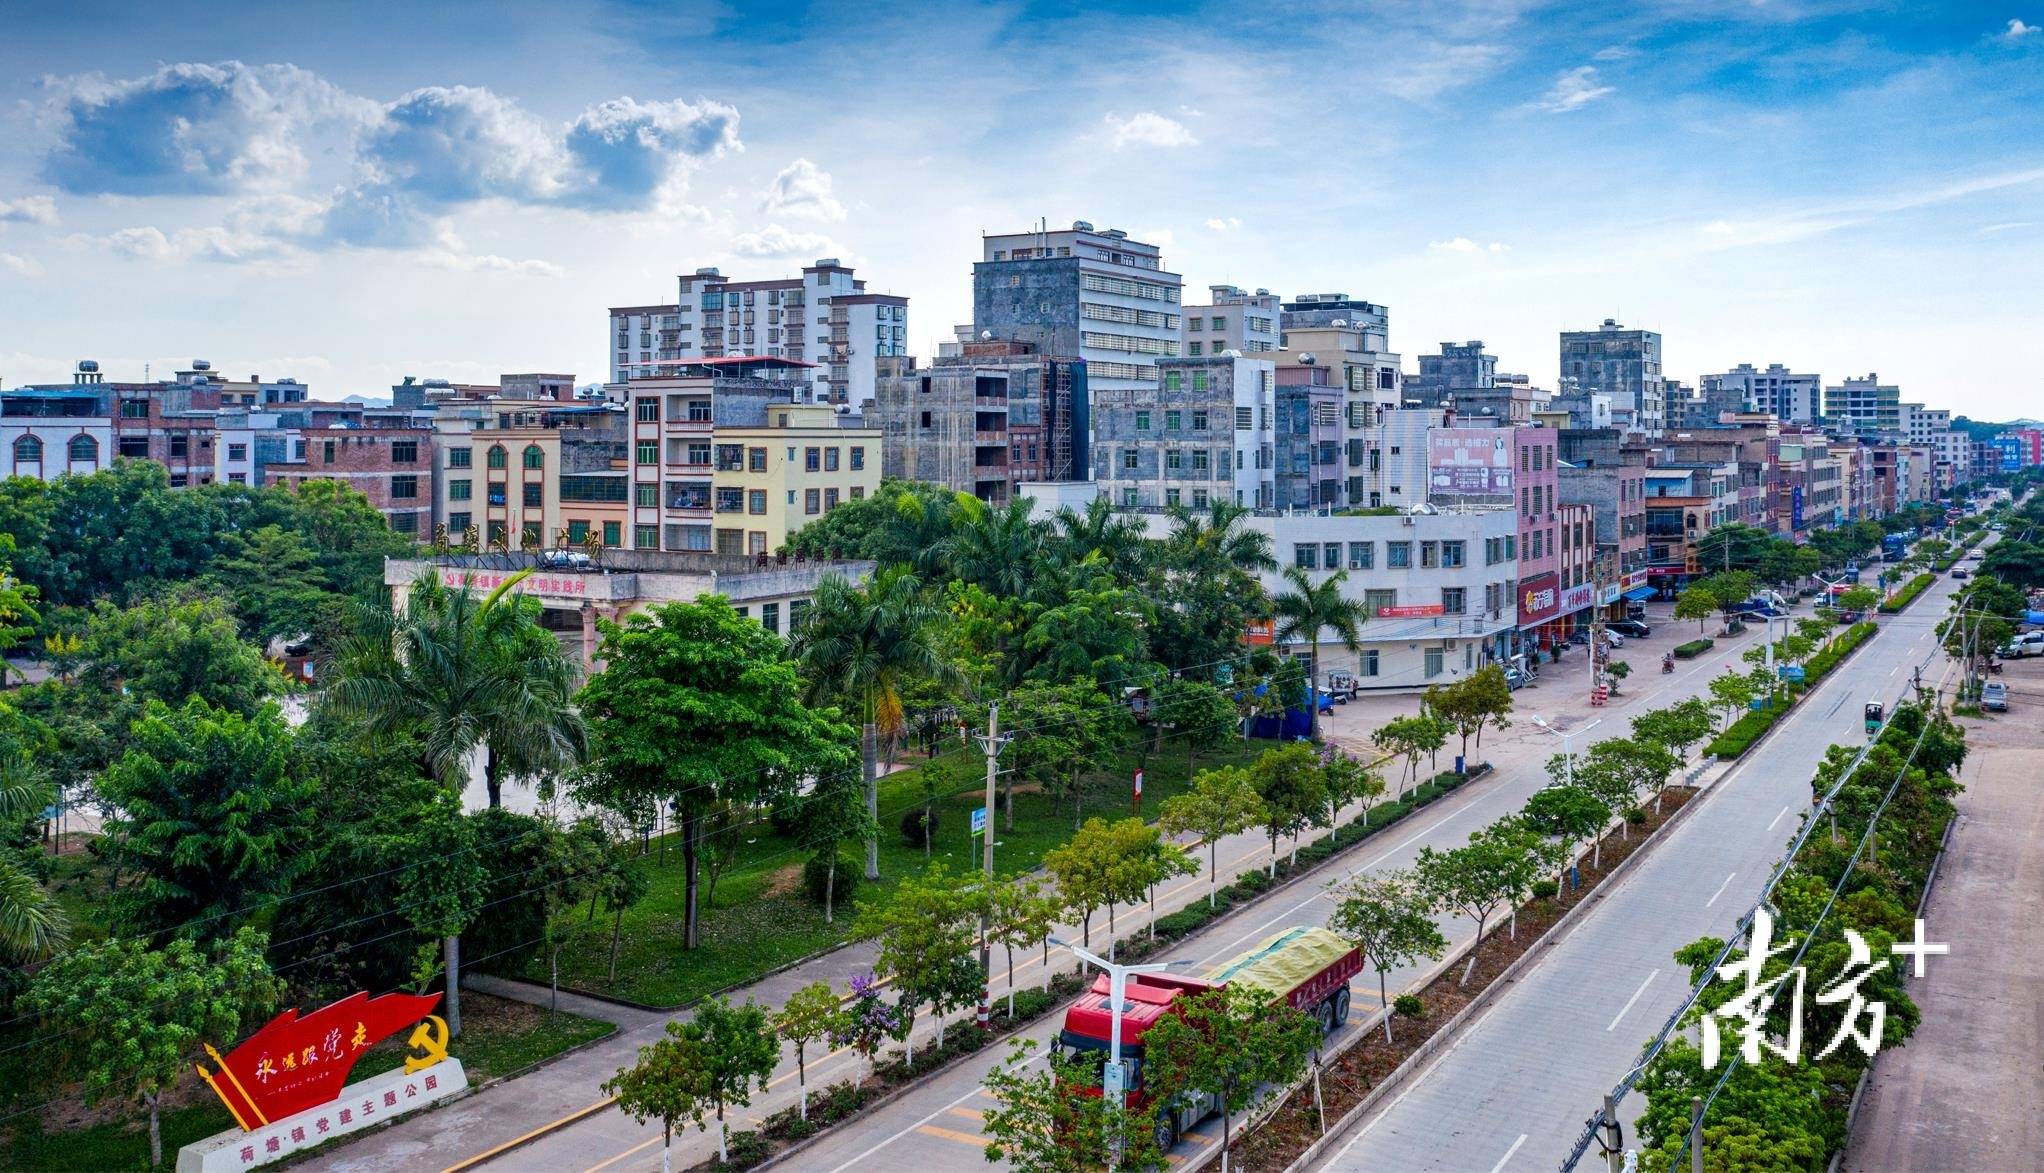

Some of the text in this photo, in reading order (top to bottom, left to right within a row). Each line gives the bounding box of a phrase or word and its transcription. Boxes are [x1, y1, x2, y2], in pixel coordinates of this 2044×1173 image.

[458, 573, 586, 594] 荷塘镇新文明实践所
[240, 1074, 437, 1163] 荷塘镇党建主题公园
